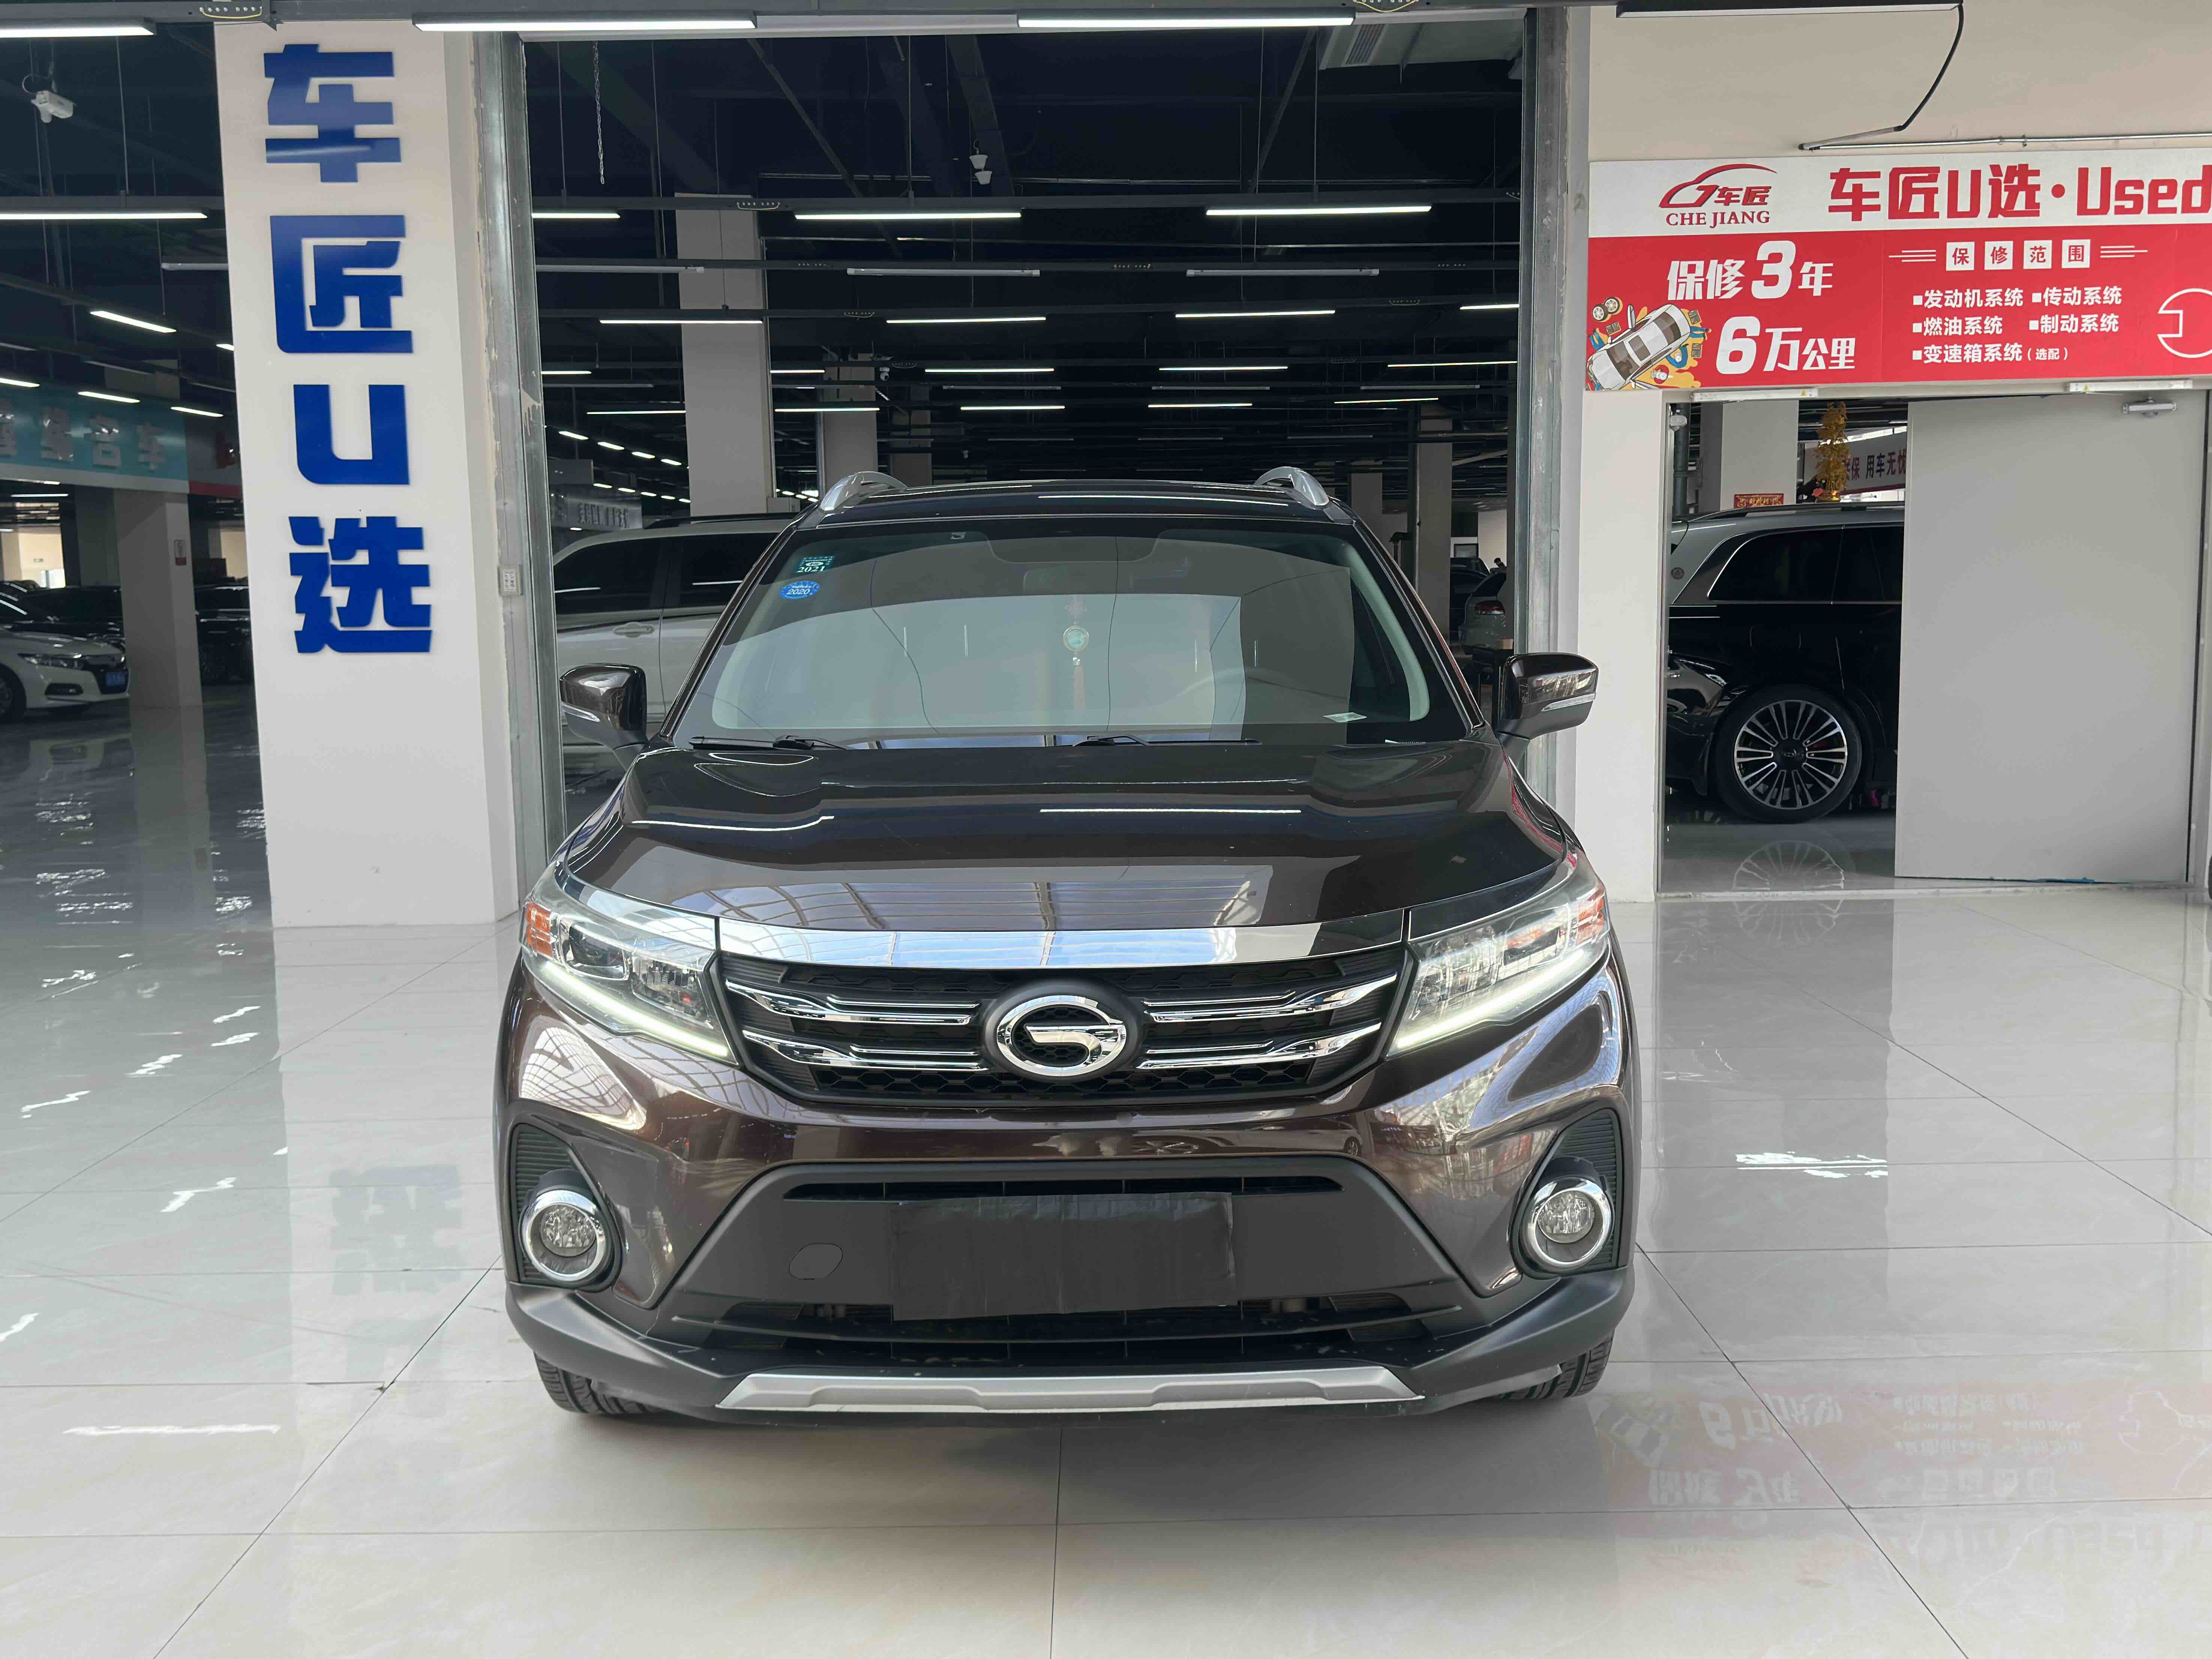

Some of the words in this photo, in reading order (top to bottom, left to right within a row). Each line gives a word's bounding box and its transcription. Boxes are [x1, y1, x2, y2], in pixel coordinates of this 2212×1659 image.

[1714, 186, 1772, 206] 车匠
[1666, 212, 1707, 226] CHE
[1710, 210, 1770, 228] JIANG
[1667, 240, 1834, 300] 保修3年
[1924, 288, 2023, 308] 发动机系统
[2043, 286, 2122, 306] 传动系统
[1923, 316, 2003, 336] 燃油系统
[2040, 314, 2119, 334] 制动系统
[263, 44, 432, 654] 车匠U选
[1716, 316, 1856, 374] 6万公里
